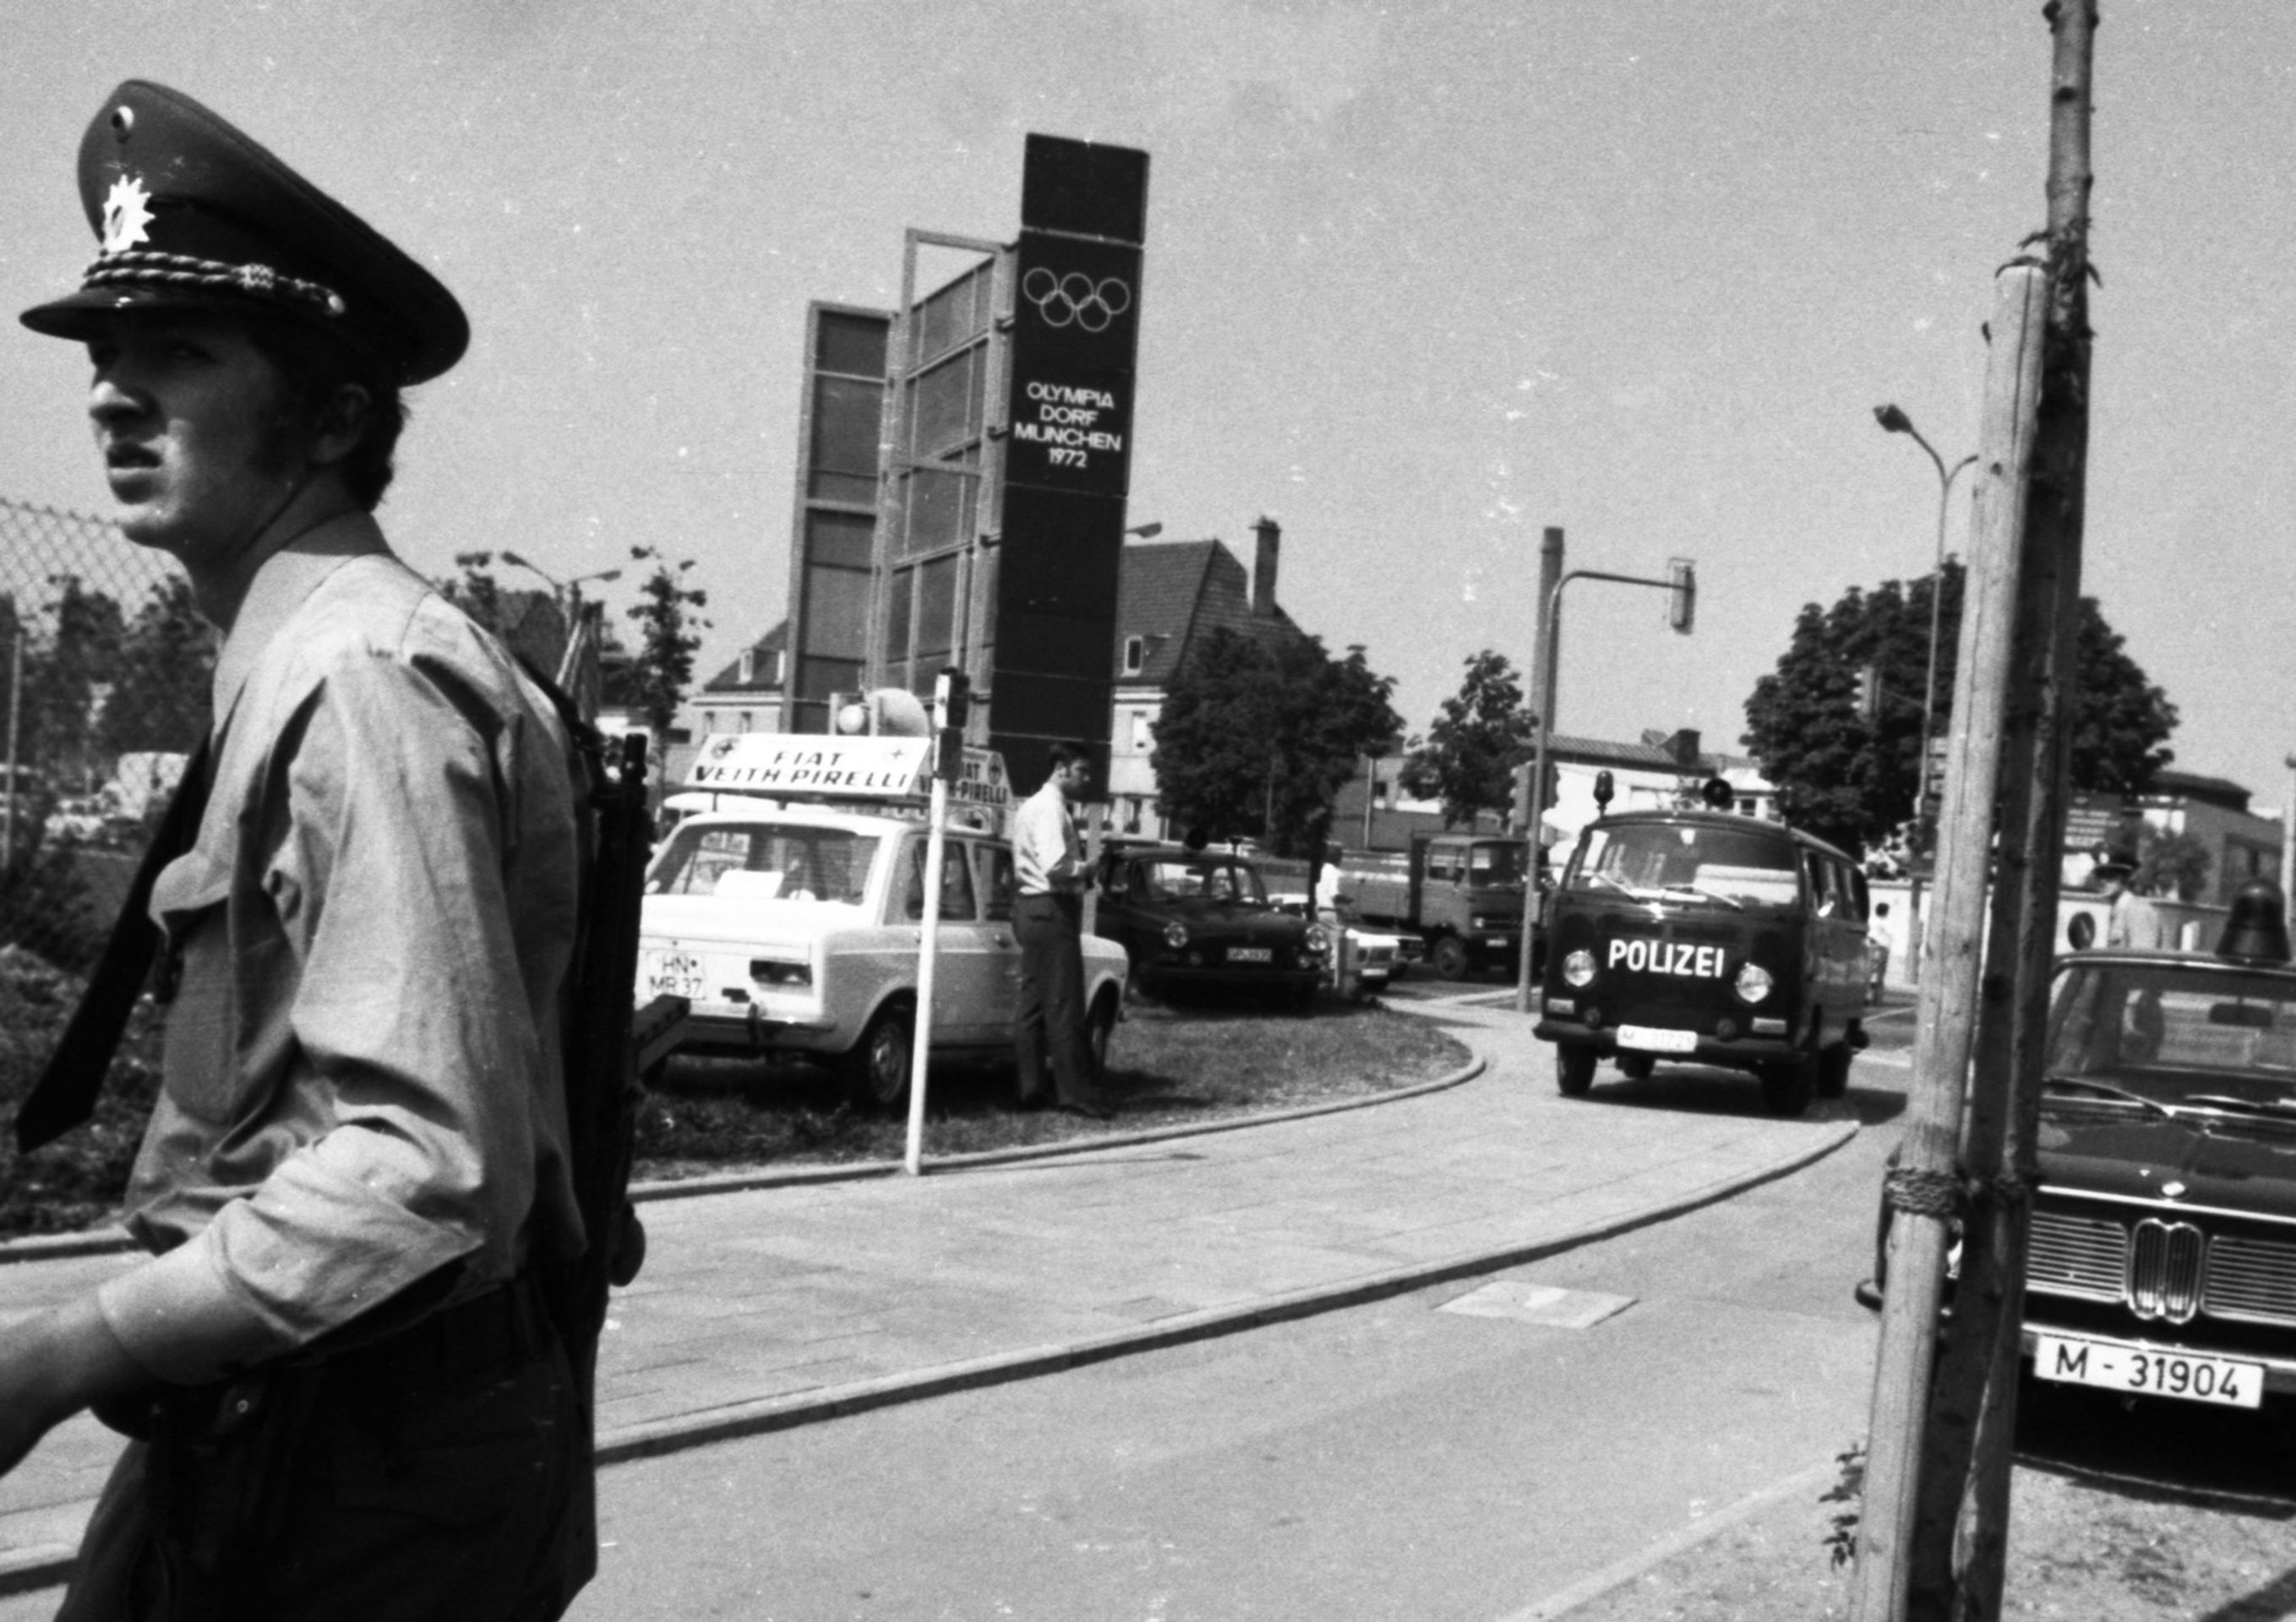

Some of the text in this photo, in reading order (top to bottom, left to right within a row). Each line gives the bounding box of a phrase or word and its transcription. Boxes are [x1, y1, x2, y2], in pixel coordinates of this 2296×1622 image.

[1027, 382, 1115, 410] OLYMPIA
[1039, 404, 1099, 427] DORF
[1049, 447, 1088, 468] 1972
[772, 750, 843, 766] FIAT
[1607, 939, 1725, 978] POLIZEI
[683, 977, 702, 997] 37
[2056, 1343, 2088, 1380] M
[2128, 1353, 2240, 1401] 31904
